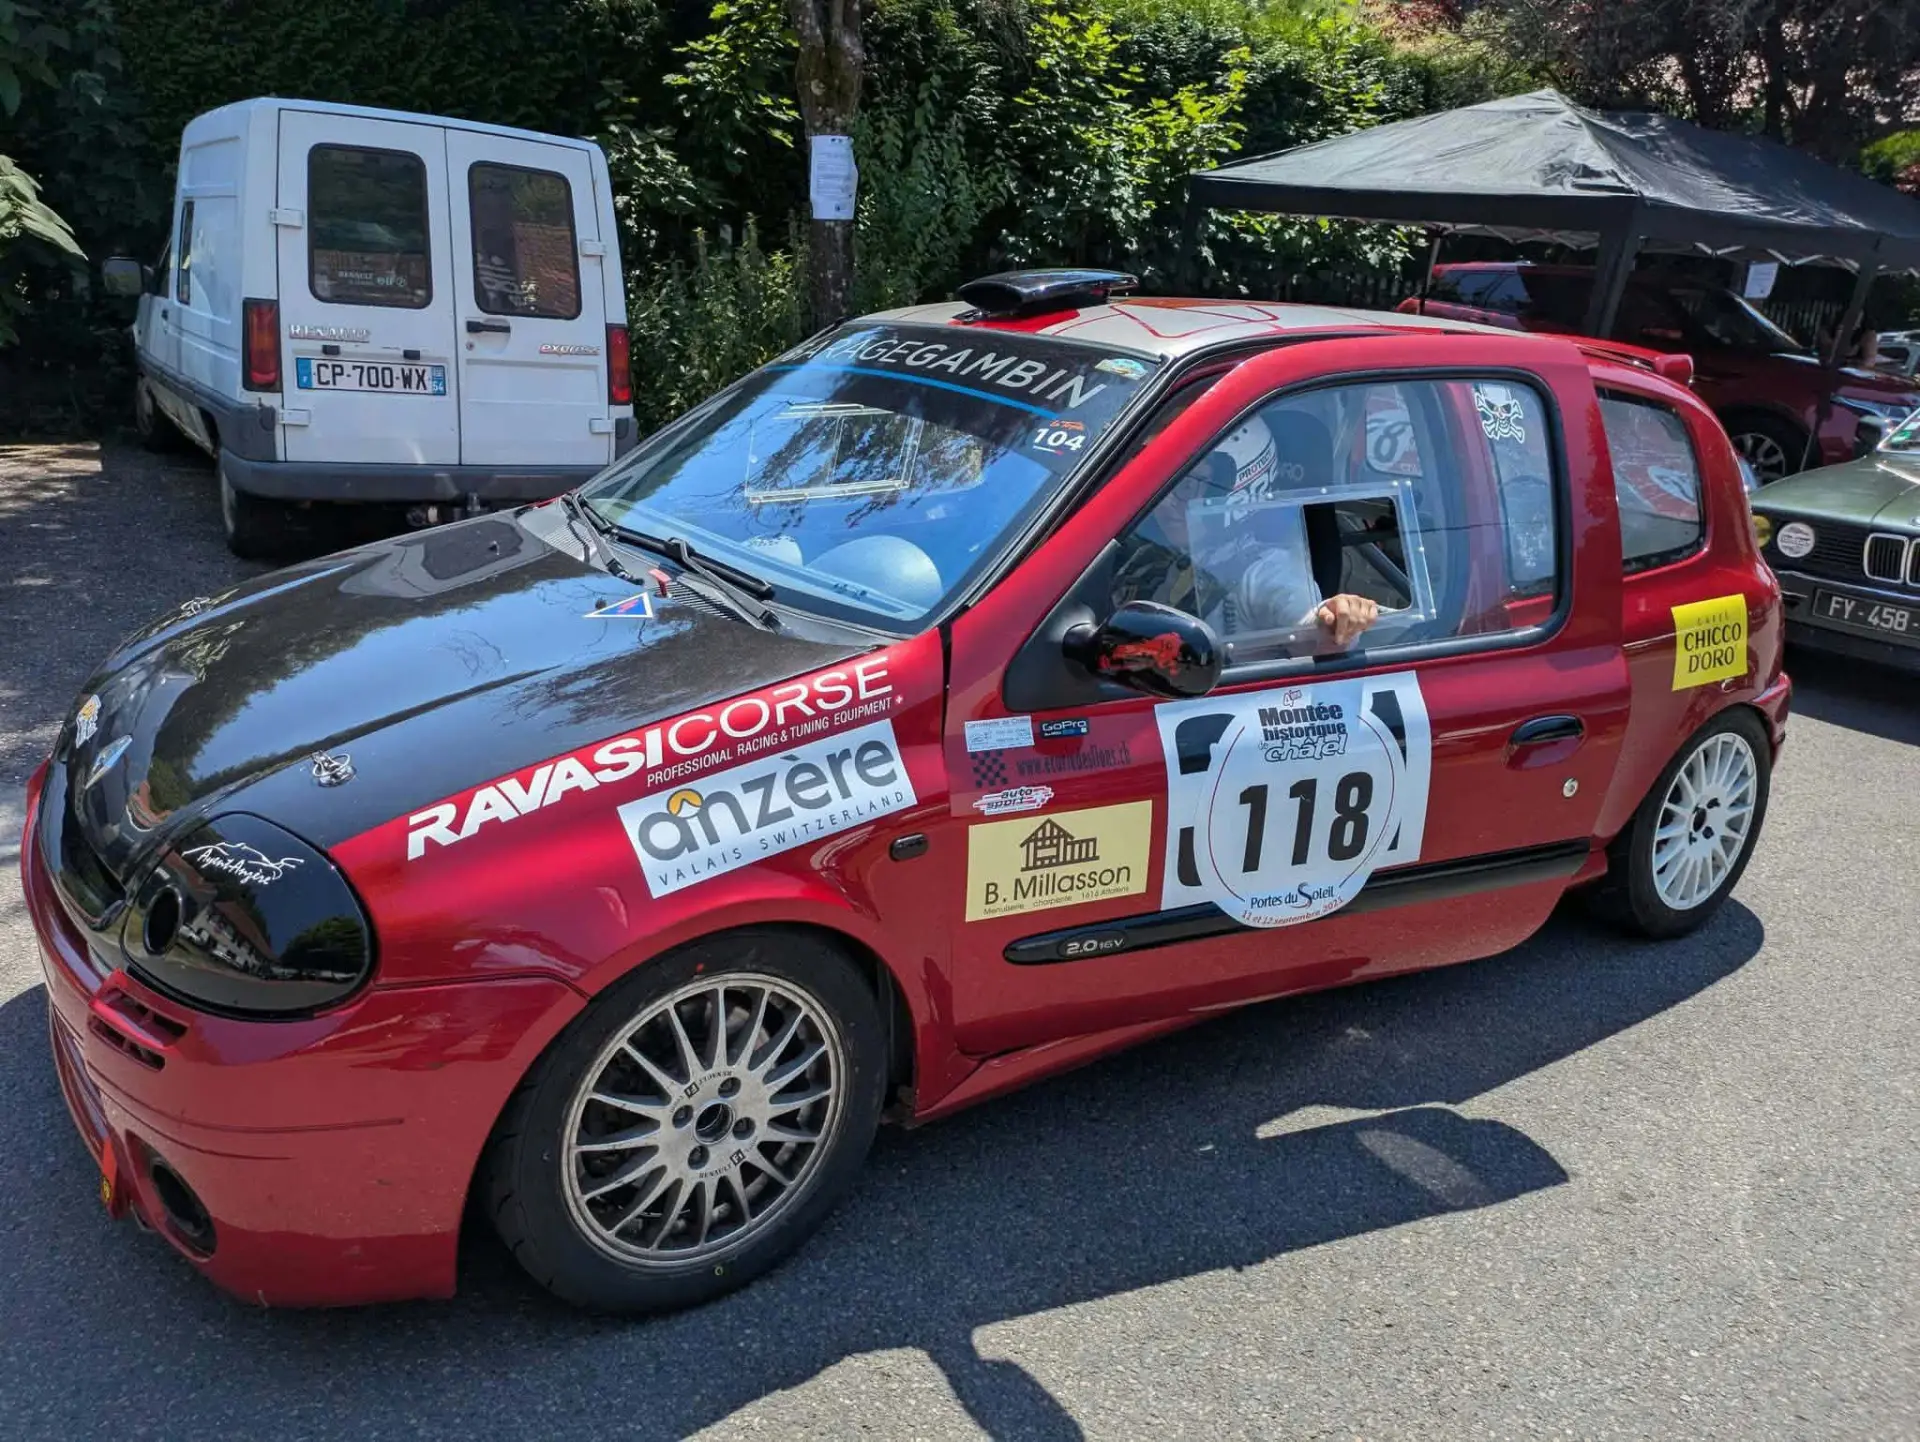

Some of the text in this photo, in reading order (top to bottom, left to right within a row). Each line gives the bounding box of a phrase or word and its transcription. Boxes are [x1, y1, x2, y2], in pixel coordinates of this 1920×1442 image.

[316, 363, 428, 391] CP-700-WX
[1034, 428, 1086, 451] 104
[1684, 622, 1742, 652] CHICCO
[1688, 646, 1734, 673] D'ORO
[1042, 720, 1088, 732] GoPro
[1258, 702, 1343, 726] Montée
[647, 697, 892, 787] PROFESSIONAL RACING & TUNING EQUIPMENT
[1263, 722, 1347, 741] historique
[638, 739, 898, 861] anzère
[986, 797, 1026, 810] sport
[1000, 787, 1033, 799] auto
[1239, 771, 1373, 873] 118
[659, 791, 904, 886] VALAIS SWITZERLAND
[985, 866, 1131, 905] B. Millasson
[1250, 882, 1334, 909] Portes du Soleil
[1066, 939, 1098, 955] 2.0
